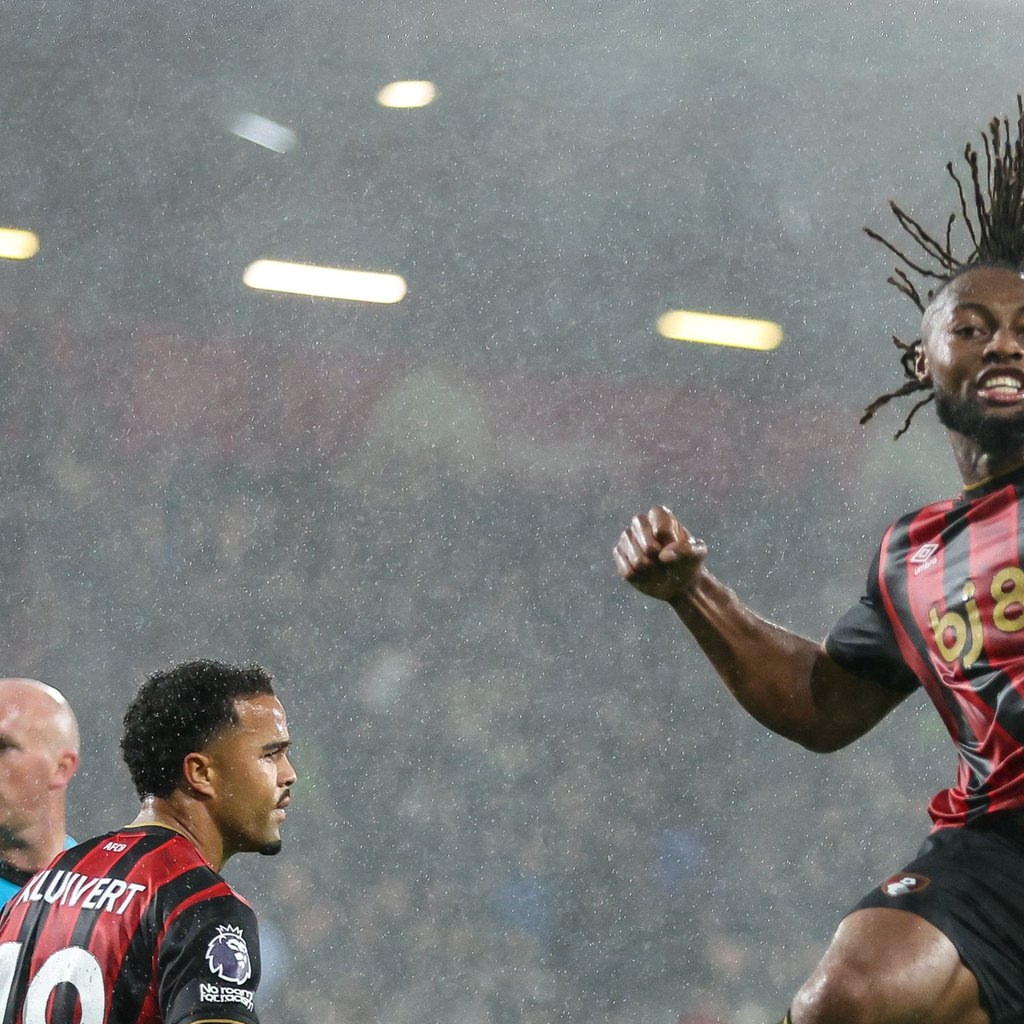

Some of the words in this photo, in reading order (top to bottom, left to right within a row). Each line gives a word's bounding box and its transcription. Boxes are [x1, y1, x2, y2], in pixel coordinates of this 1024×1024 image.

[914, 556, 938, 576] umbro
[103, 841, 127, 852] AFCB
[16, 869, 146, 915] KLUIVERT
[200, 983, 219, 994] No
[220, 986, 254, 1001] room
